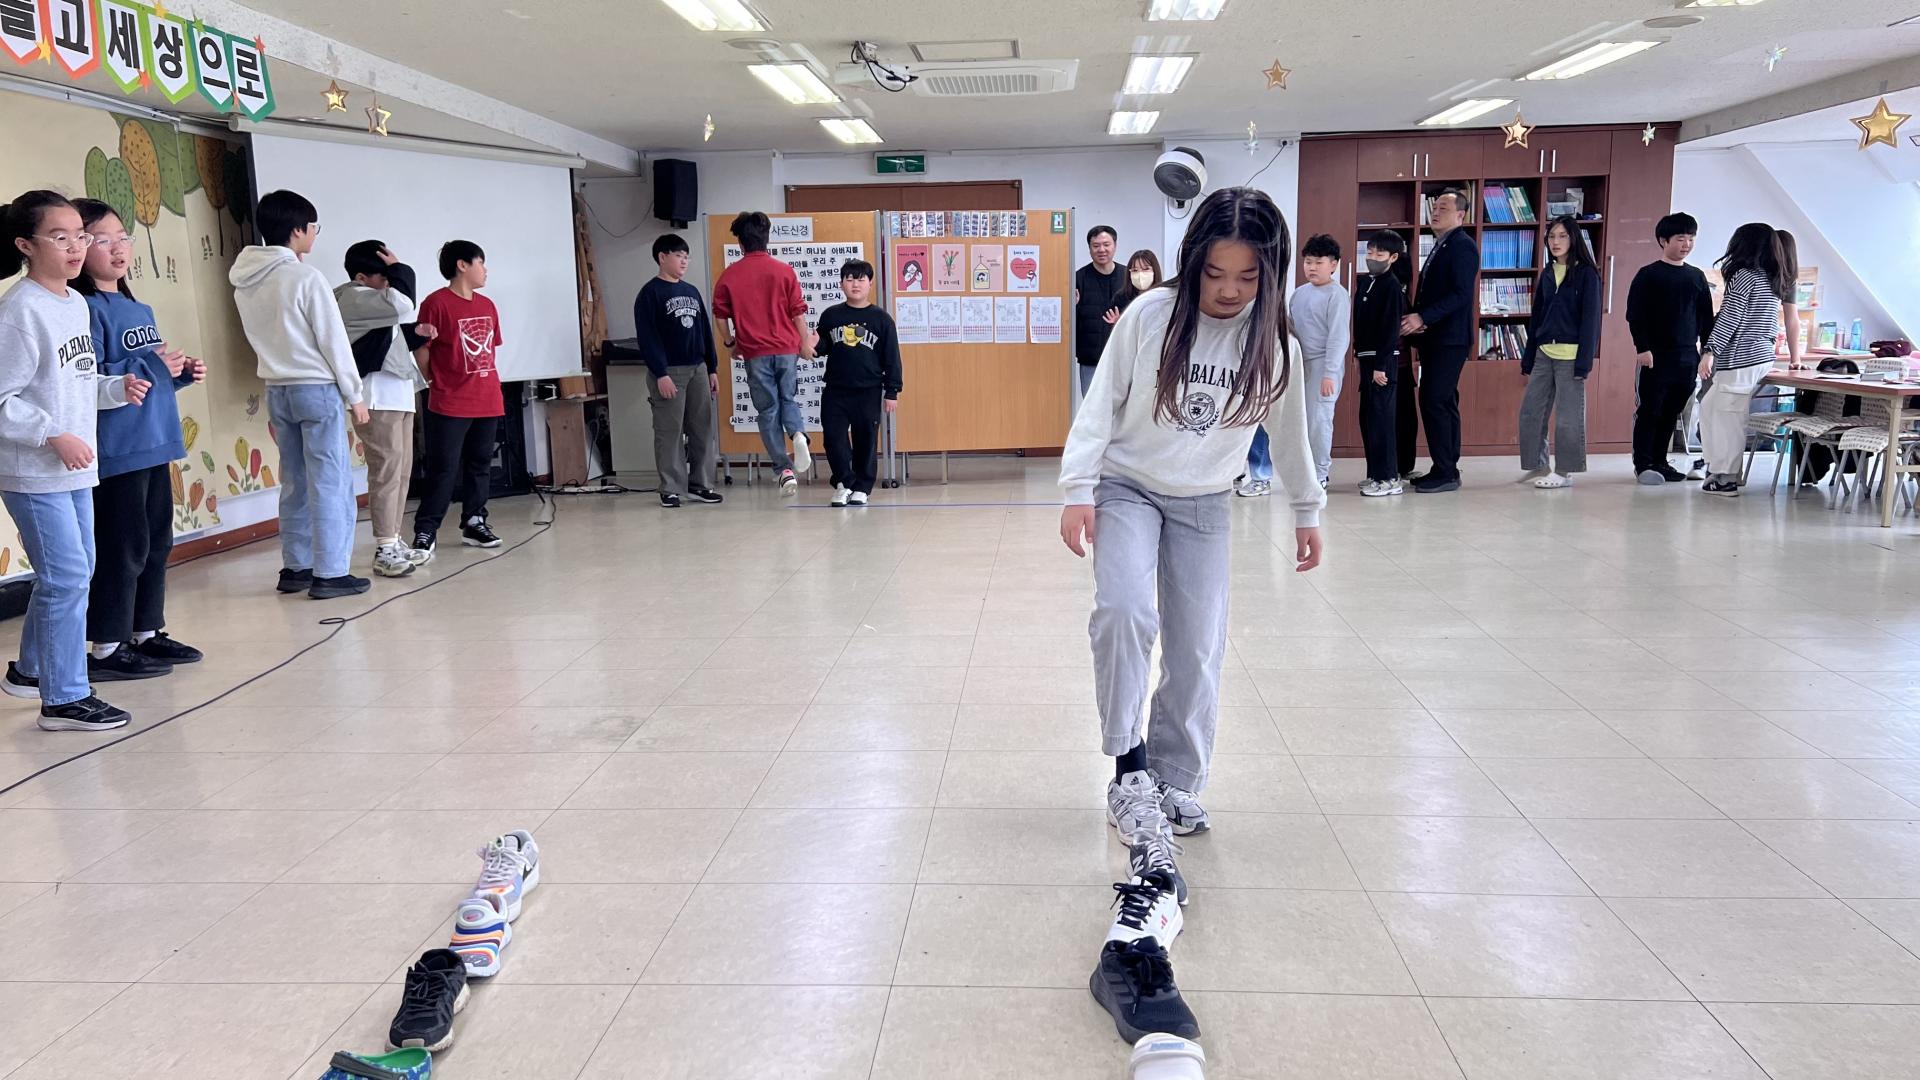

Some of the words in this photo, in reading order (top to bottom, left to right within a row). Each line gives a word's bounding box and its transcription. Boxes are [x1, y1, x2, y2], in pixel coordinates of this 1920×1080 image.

[771, 225, 809, 236] 사도신경
[806, 247, 826, 255] 하나님
[831, 246, 858, 255] 아버지를
